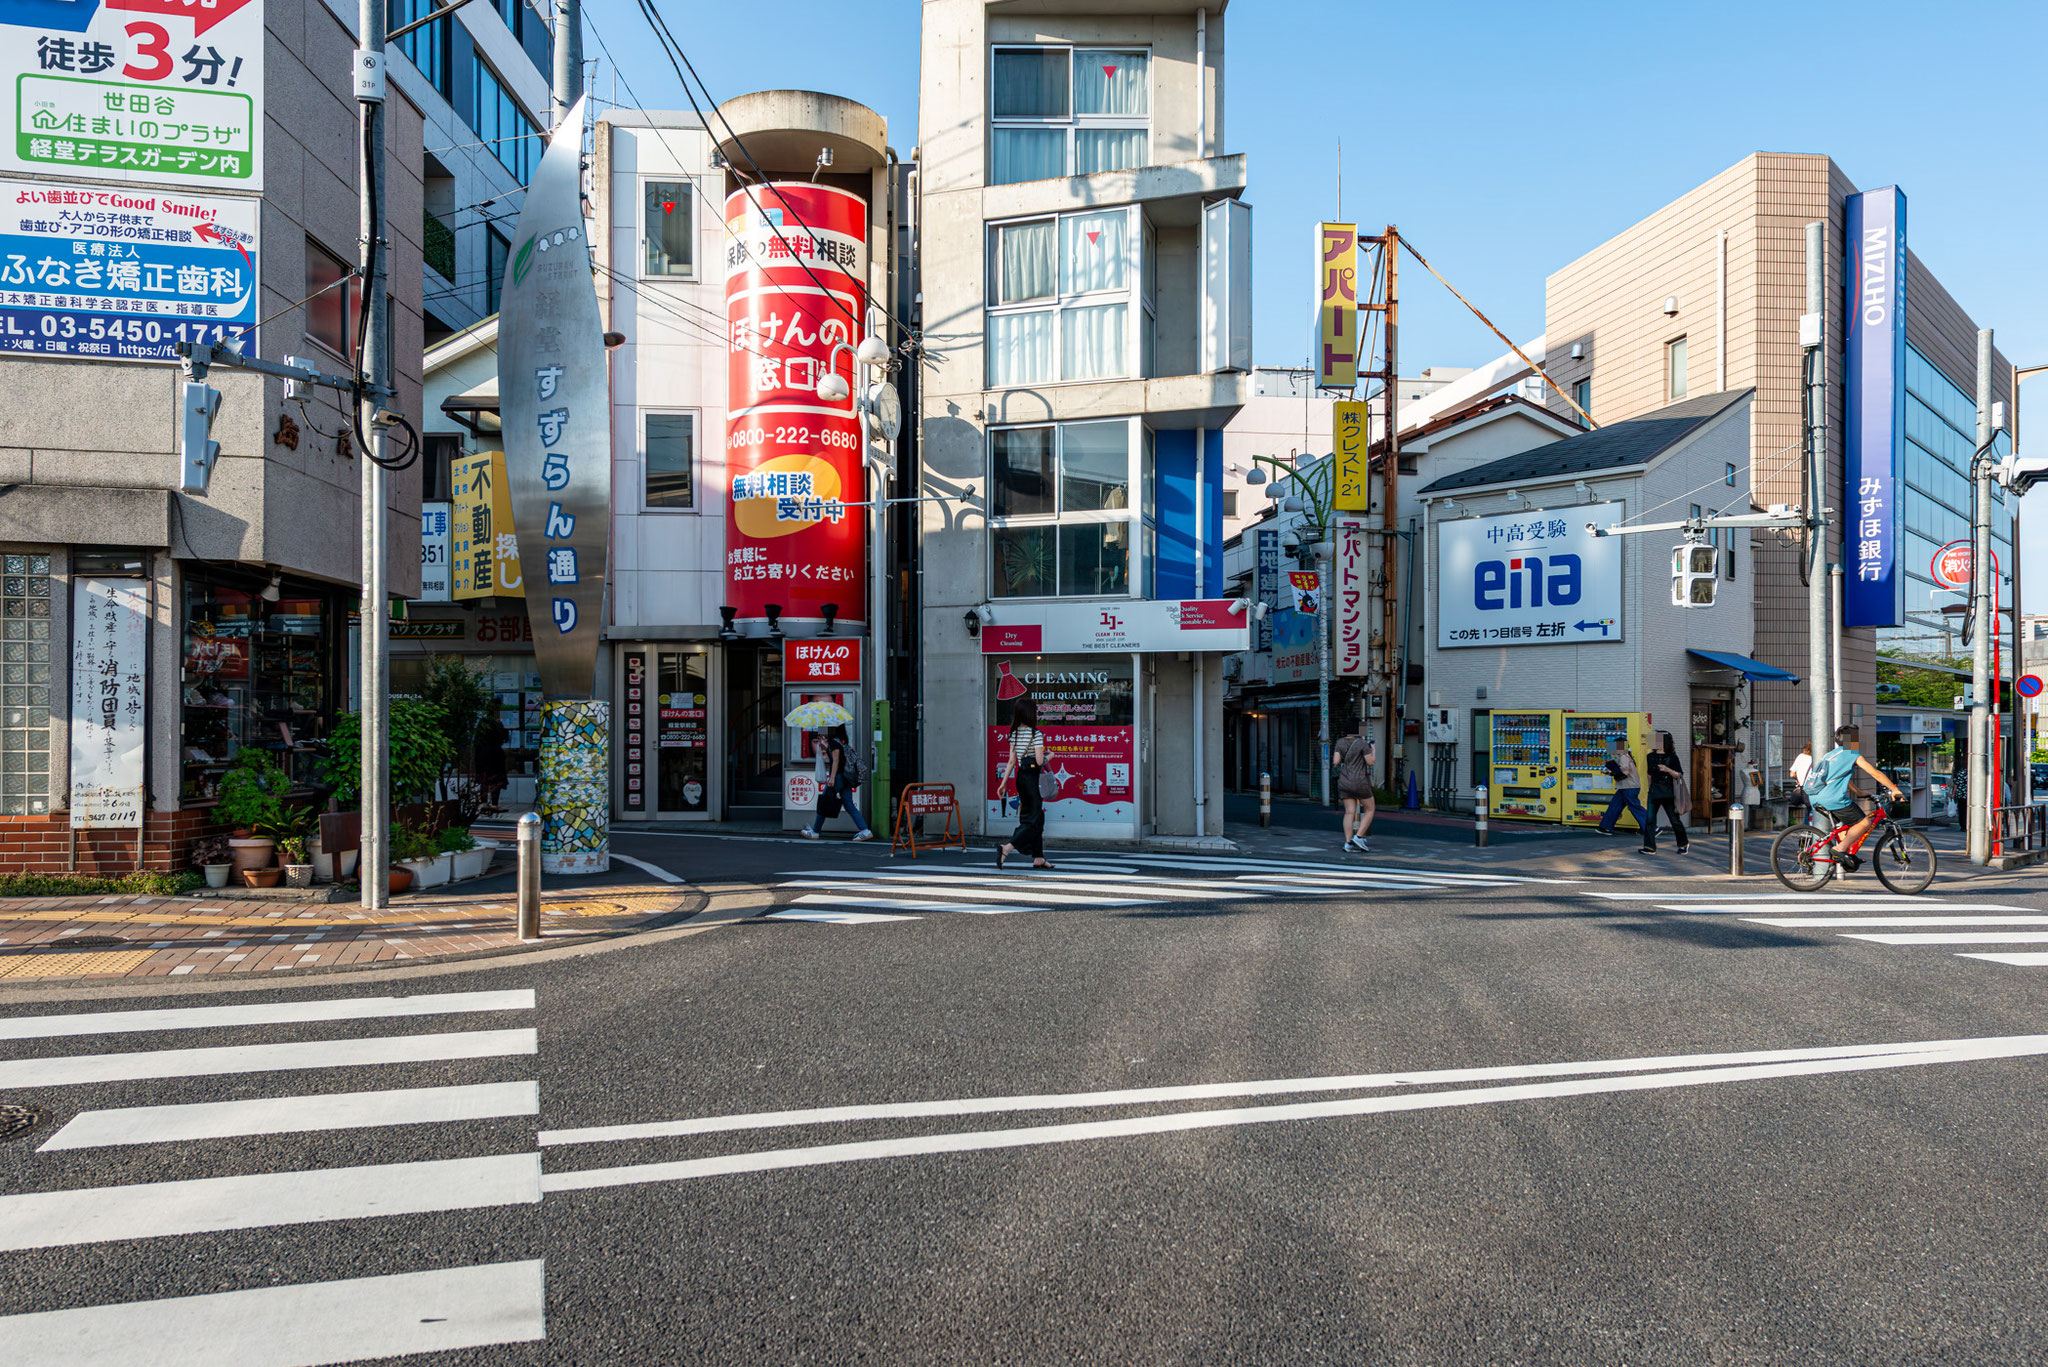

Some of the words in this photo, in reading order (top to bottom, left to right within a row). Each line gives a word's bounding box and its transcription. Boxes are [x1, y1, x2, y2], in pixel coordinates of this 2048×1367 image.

[103, 92, 176, 116] 世田谷
[64, 112, 241, 145] 住まいのプラザ
[30, 137, 240, 175] 経堂テラスガーデン内
[59, 209, 154, 227] 大人から子供まで
[162, 199, 217, 222] Smile!
[20, 219, 193, 244] 歯並び・アゴの形の矯正相談
[217, 235, 238, 249] 入る
[72, 241, 141, 260] 医療法人
[1, 253, 244, 299] ふなき矯正歯科
[1864, 226, 1887, 327] MIZUHO
[1323, 230, 1355, 376] アパート
[730, 312, 849, 353] ほけんの
[733, 426, 857, 450] 0800-222-6680
[733, 473, 812, 500] 無料相談
[536, 365, 579, 635] すずらん通り
[778, 497, 844, 523] 受付中
[470, 459, 493, 591] 不動産
[1487, 519, 1567, 544] 中高受験
[1858, 477, 1883, 582] みずほ銀行
[495, 532, 522, 589] 探し
[728, 547, 767, 565] お気軽に
[734, 563, 855, 582] お立ち寄りください
[1474, 553, 1582, 611] ena
[1342, 521, 1361, 673] アパート・マンション
[1005, 632, 1018, 640] Dry
[1449, 629, 1480, 641] この先
[1483, 626, 1533, 639] 1つ目信号
[1536, 622, 1566, 637] 左折
[796, 645, 850, 660] ほけんの
[808, 662, 835, 676] 窓口
[1024, 671, 1108, 684] CLEANING
[1031, 692, 1055, 700] HIGH
[1057, 691, 1101, 700] QUALITY
